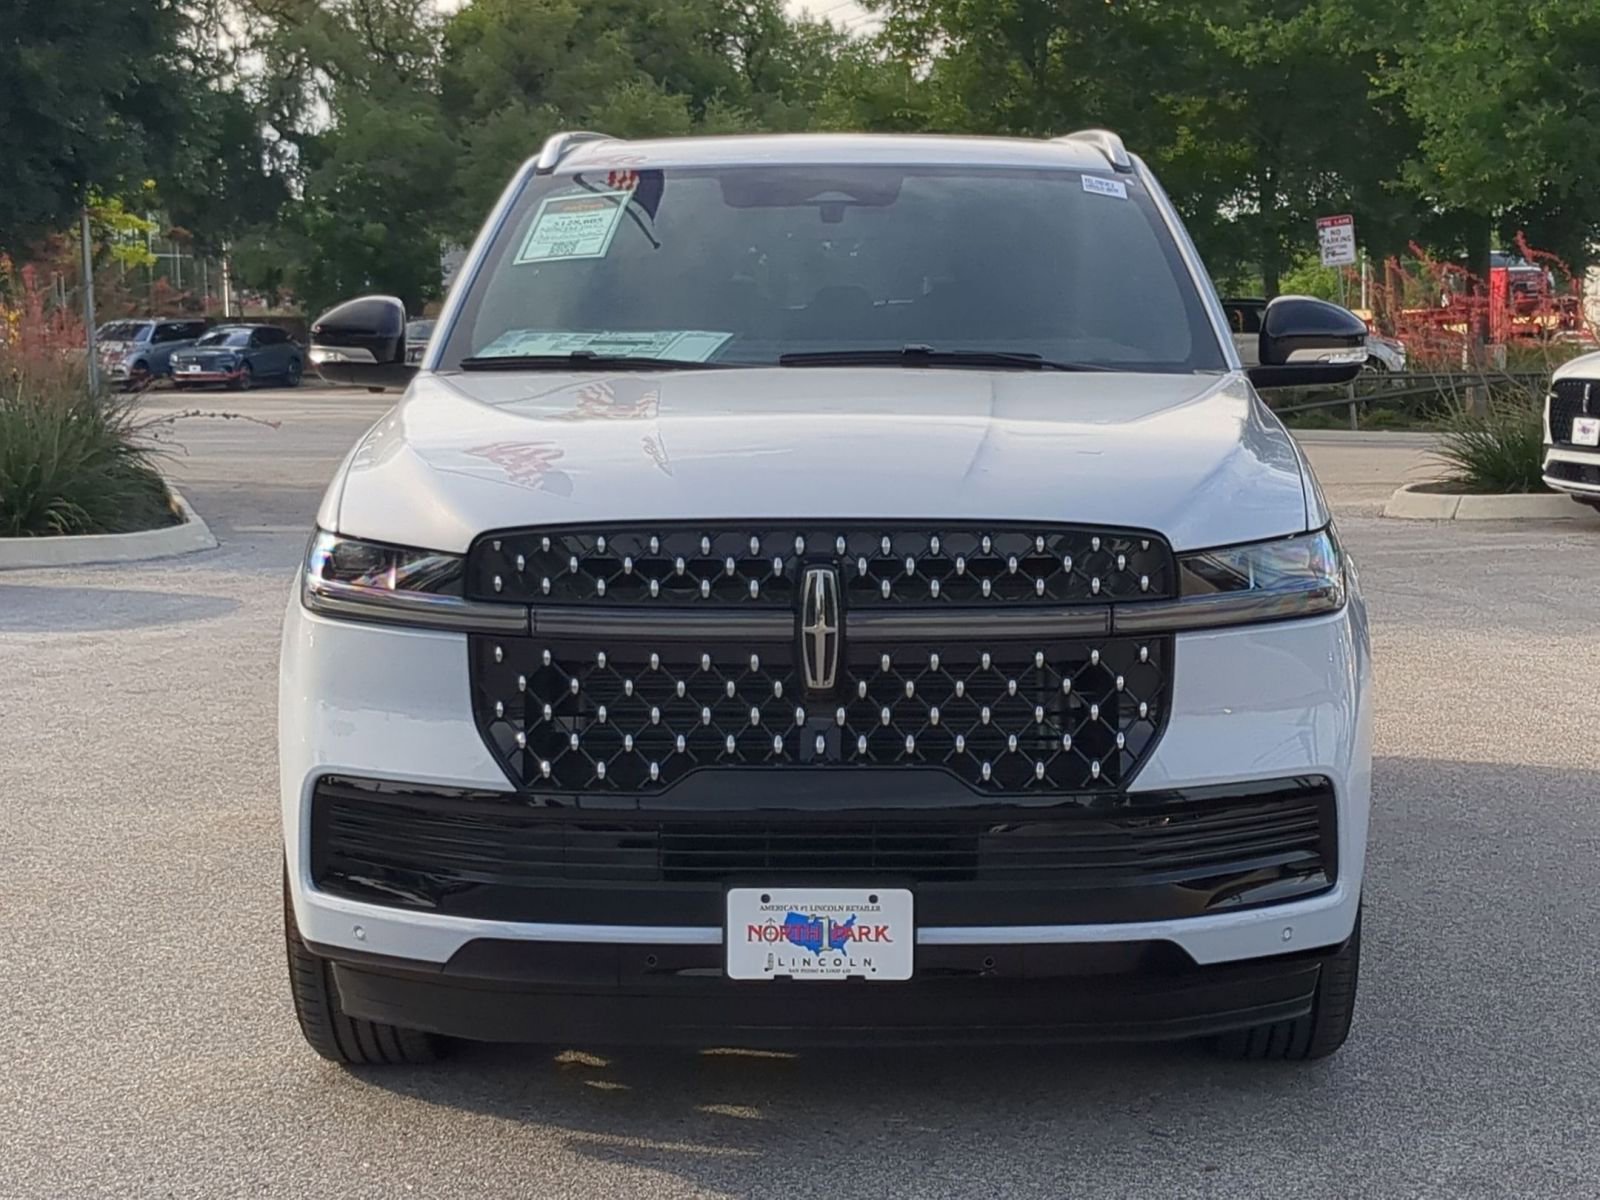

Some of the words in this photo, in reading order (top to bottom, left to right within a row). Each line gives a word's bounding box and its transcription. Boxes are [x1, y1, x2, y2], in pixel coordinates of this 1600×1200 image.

[1322, 235, 1352, 244] PARKING
[759, 904, 799, 912] AMERICA'S
[810, 904, 844, 912] LINCOLN
[845, 904, 881, 912] RETAILER
[747, 925, 820, 943] NORTH
[832, 925, 893, 943] PARK
[778, 958, 872, 967] LINCOLN
